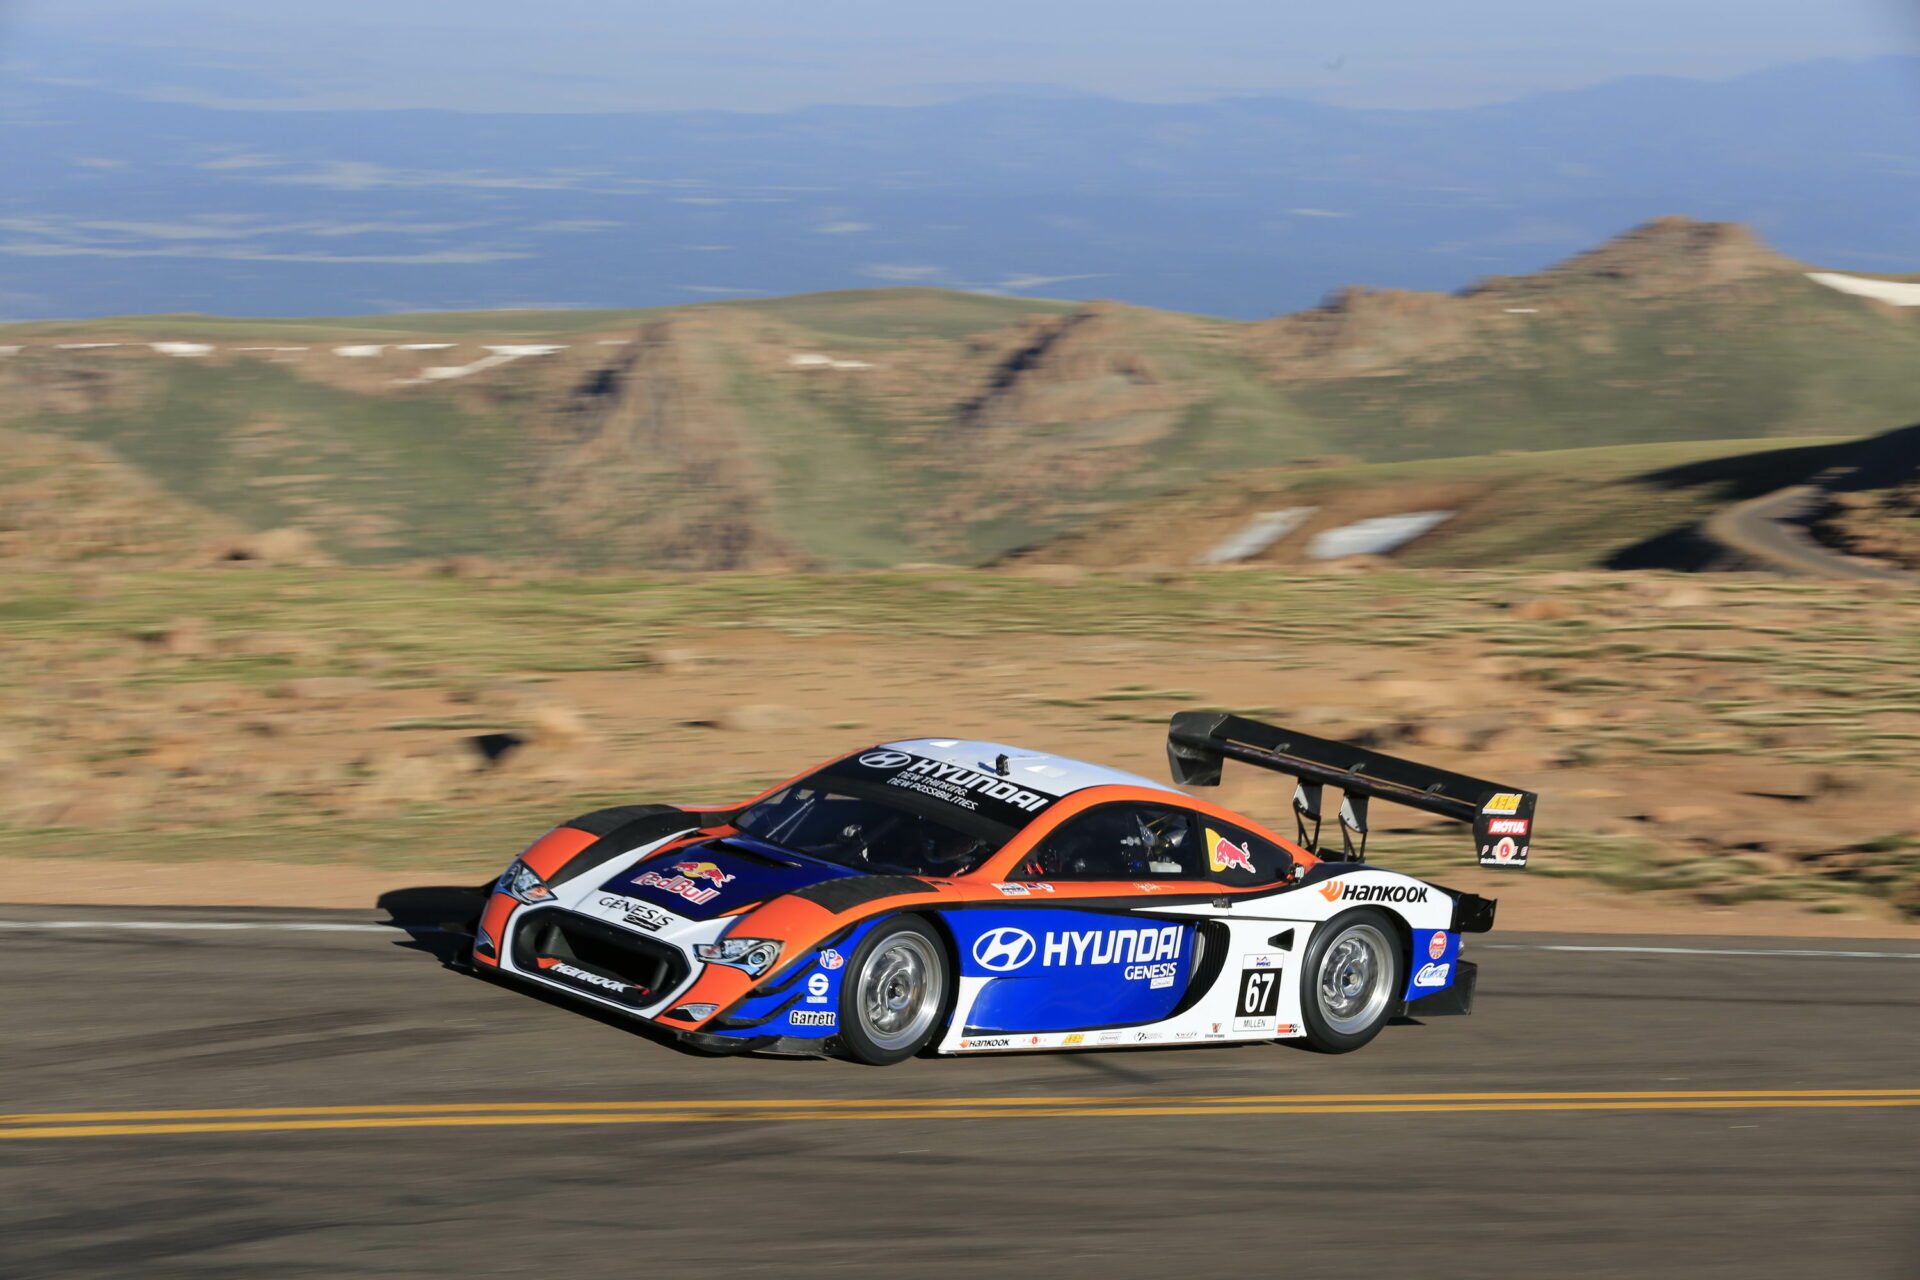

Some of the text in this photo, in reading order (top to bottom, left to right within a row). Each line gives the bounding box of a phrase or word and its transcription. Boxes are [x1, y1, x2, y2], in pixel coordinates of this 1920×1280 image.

[886, 777, 909, 790] NEW
[897, 771, 922, 783] NEW
[907, 758, 1049, 812] HYUNDAI
[1489, 819, 1526, 833] MOTUL
[599, 896, 674, 926] GENESIS
[1043, 925, 1184, 967] HYUNDAI
[1124, 962, 1178, 980] GENESIS
[1244, 972, 1275, 1014] 67
[790, 1010, 835, 1026] Garrett
[1243, 1018, 1267, 1029] MILLEN
